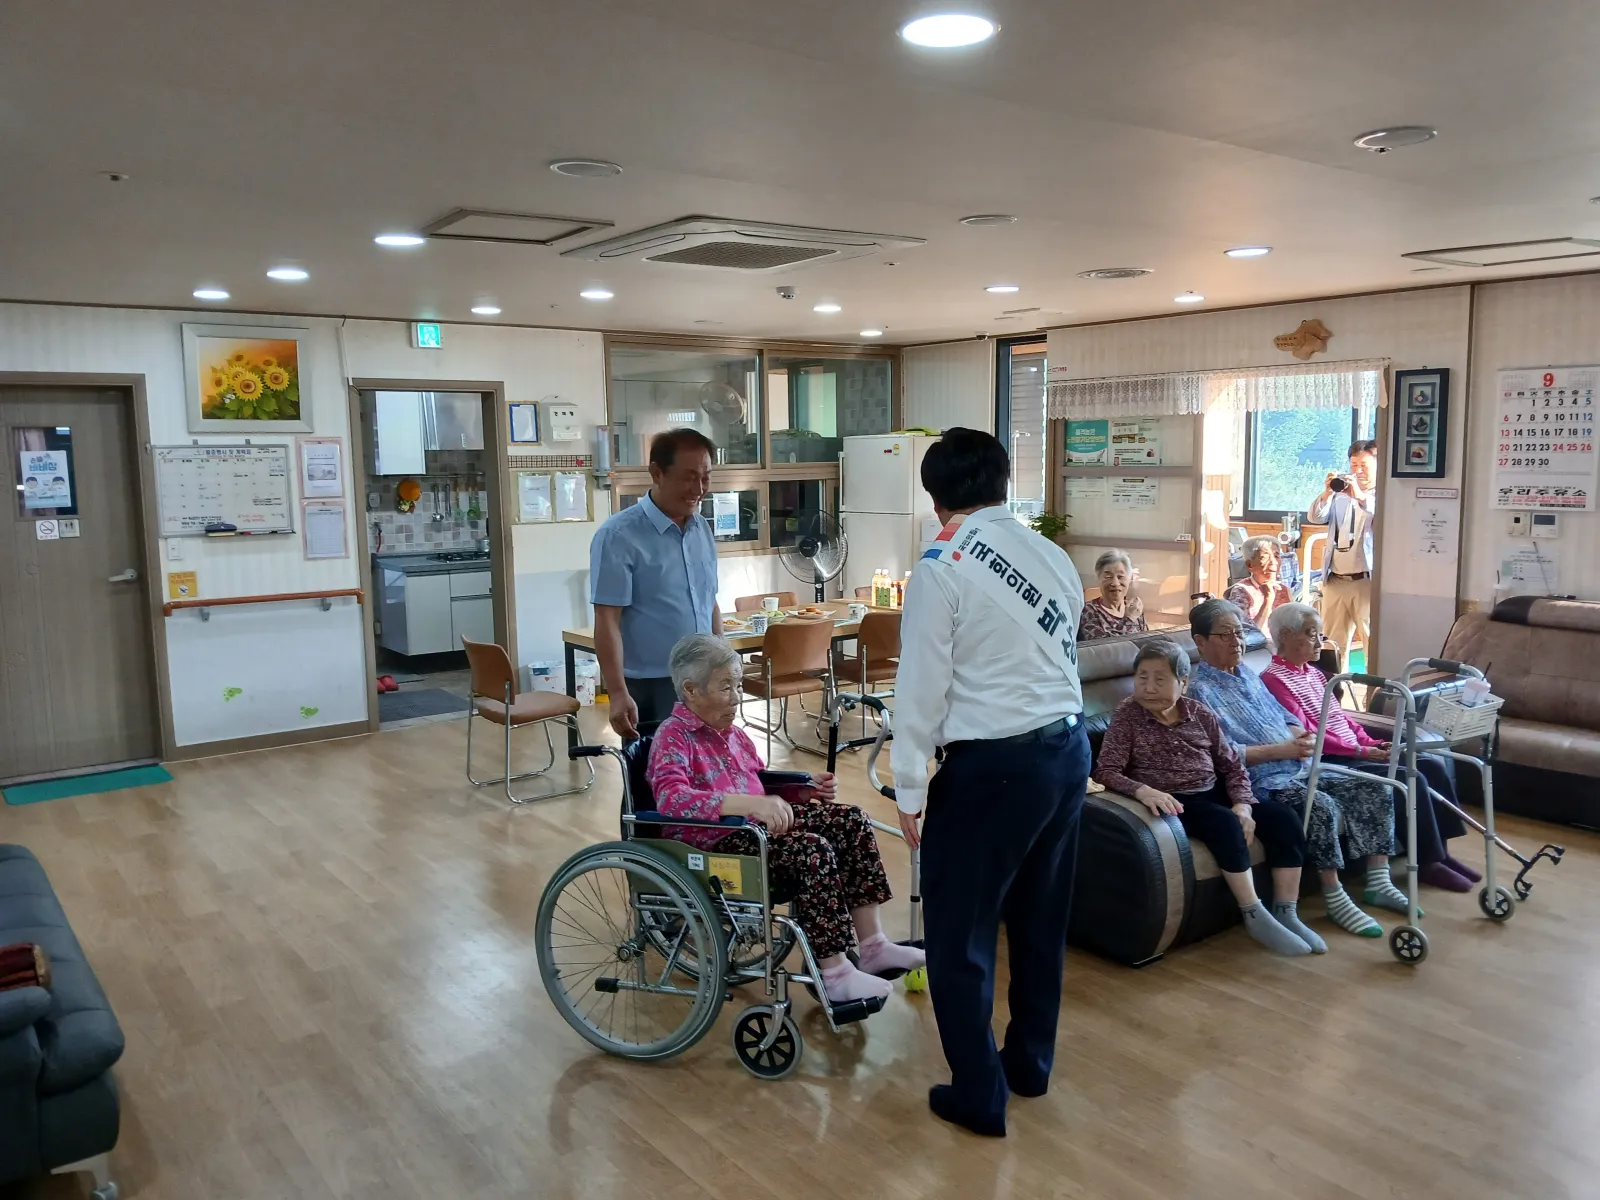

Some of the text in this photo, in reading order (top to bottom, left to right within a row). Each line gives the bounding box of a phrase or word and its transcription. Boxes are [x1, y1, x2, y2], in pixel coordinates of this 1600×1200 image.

[1543, 373, 1554, 387] 9
[1498, 488, 1587, 496] 우리주유소
[958, 527, 982, 552] 국민의힘
[969, 540, 1078, 666] 국회의원 박성
